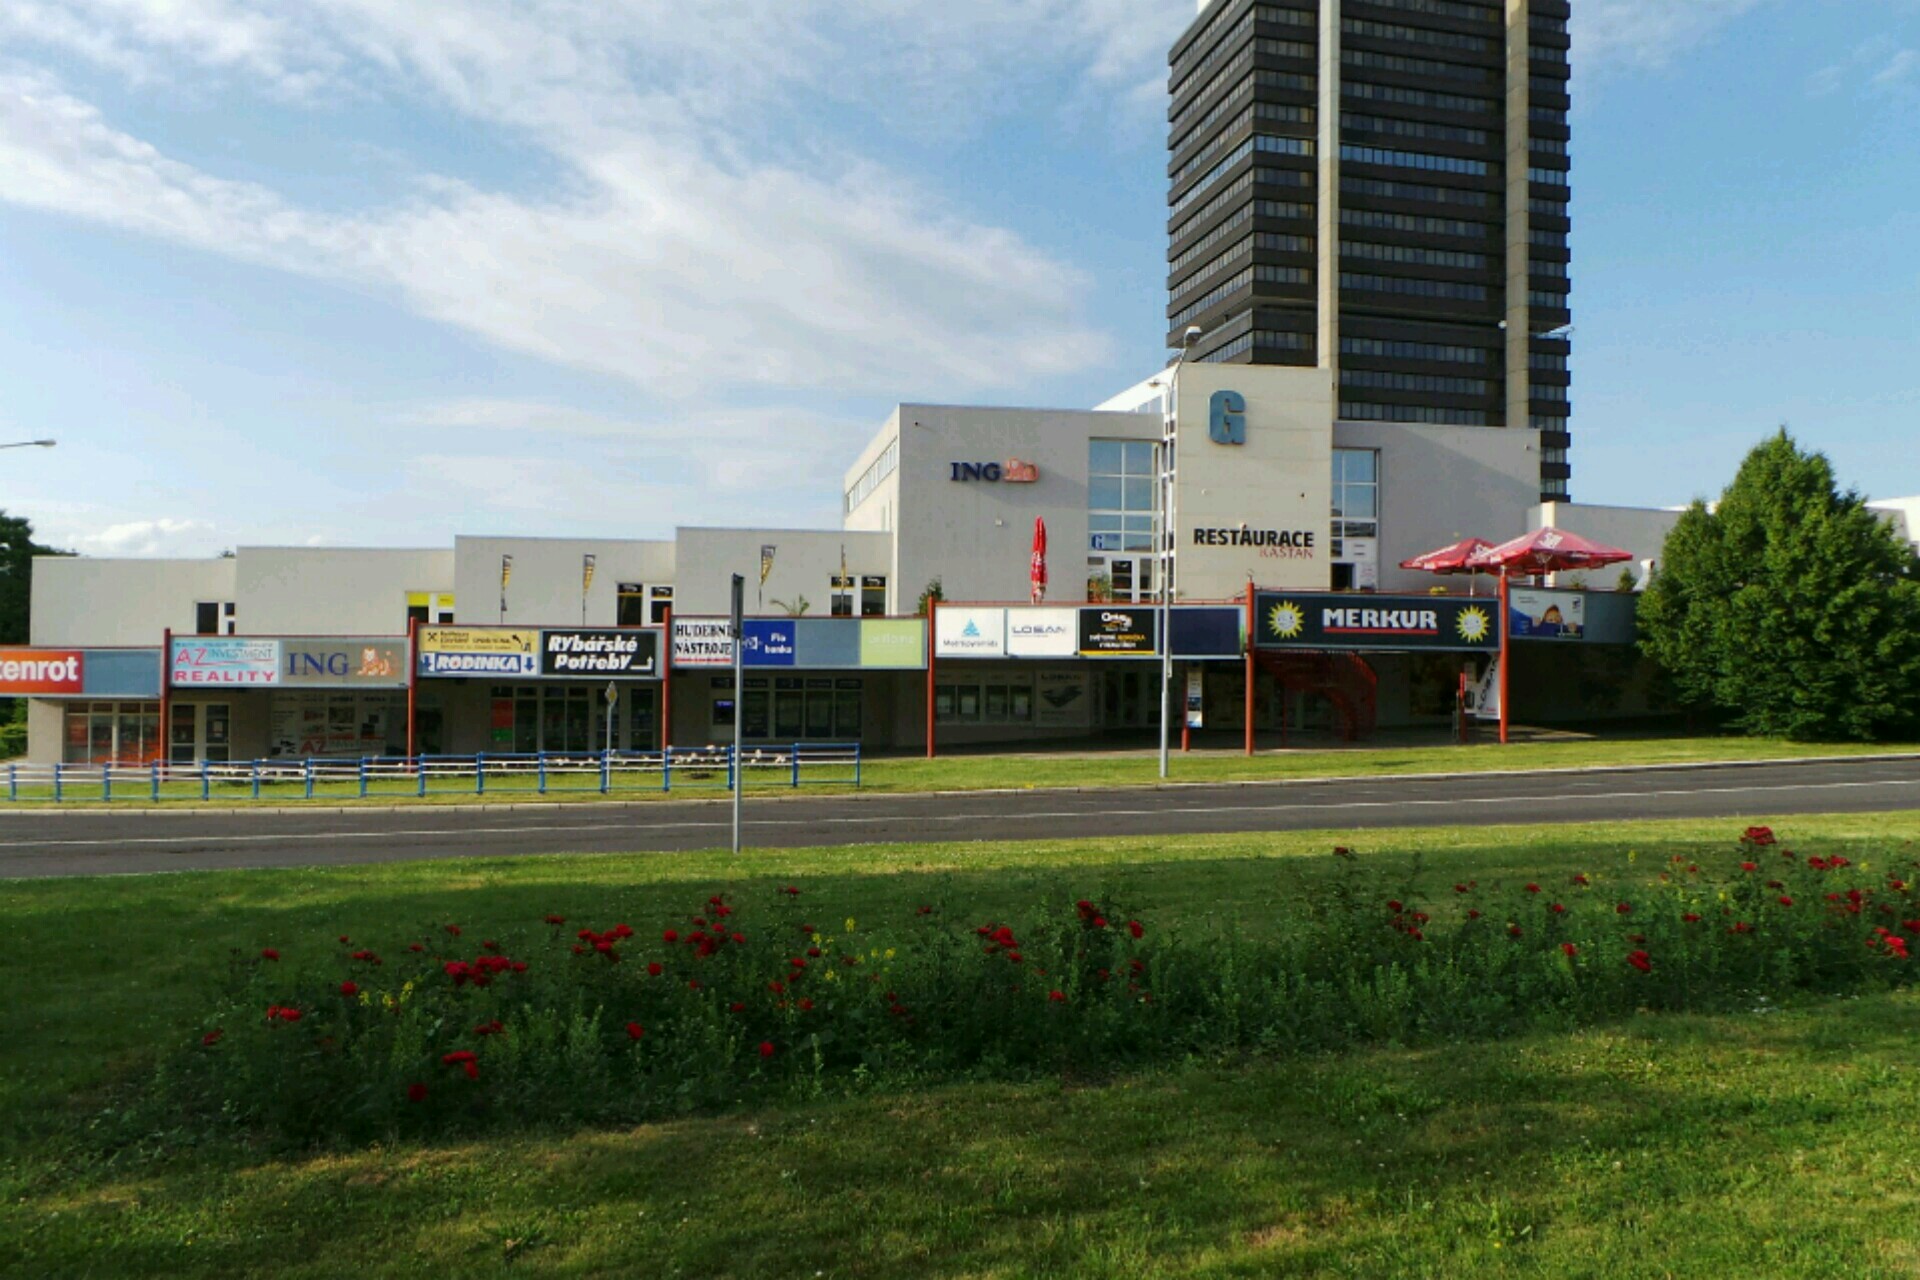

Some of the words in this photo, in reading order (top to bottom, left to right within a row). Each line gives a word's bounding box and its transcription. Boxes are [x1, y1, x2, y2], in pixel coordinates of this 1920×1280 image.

[1209, 390, 1246, 445] G
[950, 462, 1000, 481] ING
[1194, 528, 1315, 548] RESTAURACE
[1322, 608, 1438, 629] MERKUR
[1012, 625, 1066, 634] LOSAN
[175, 647, 208, 666] AZ
[288, 653, 349, 676] ING
[436, 655, 520, 671] RODINKA
[174, 670, 275, 682] REALITY
